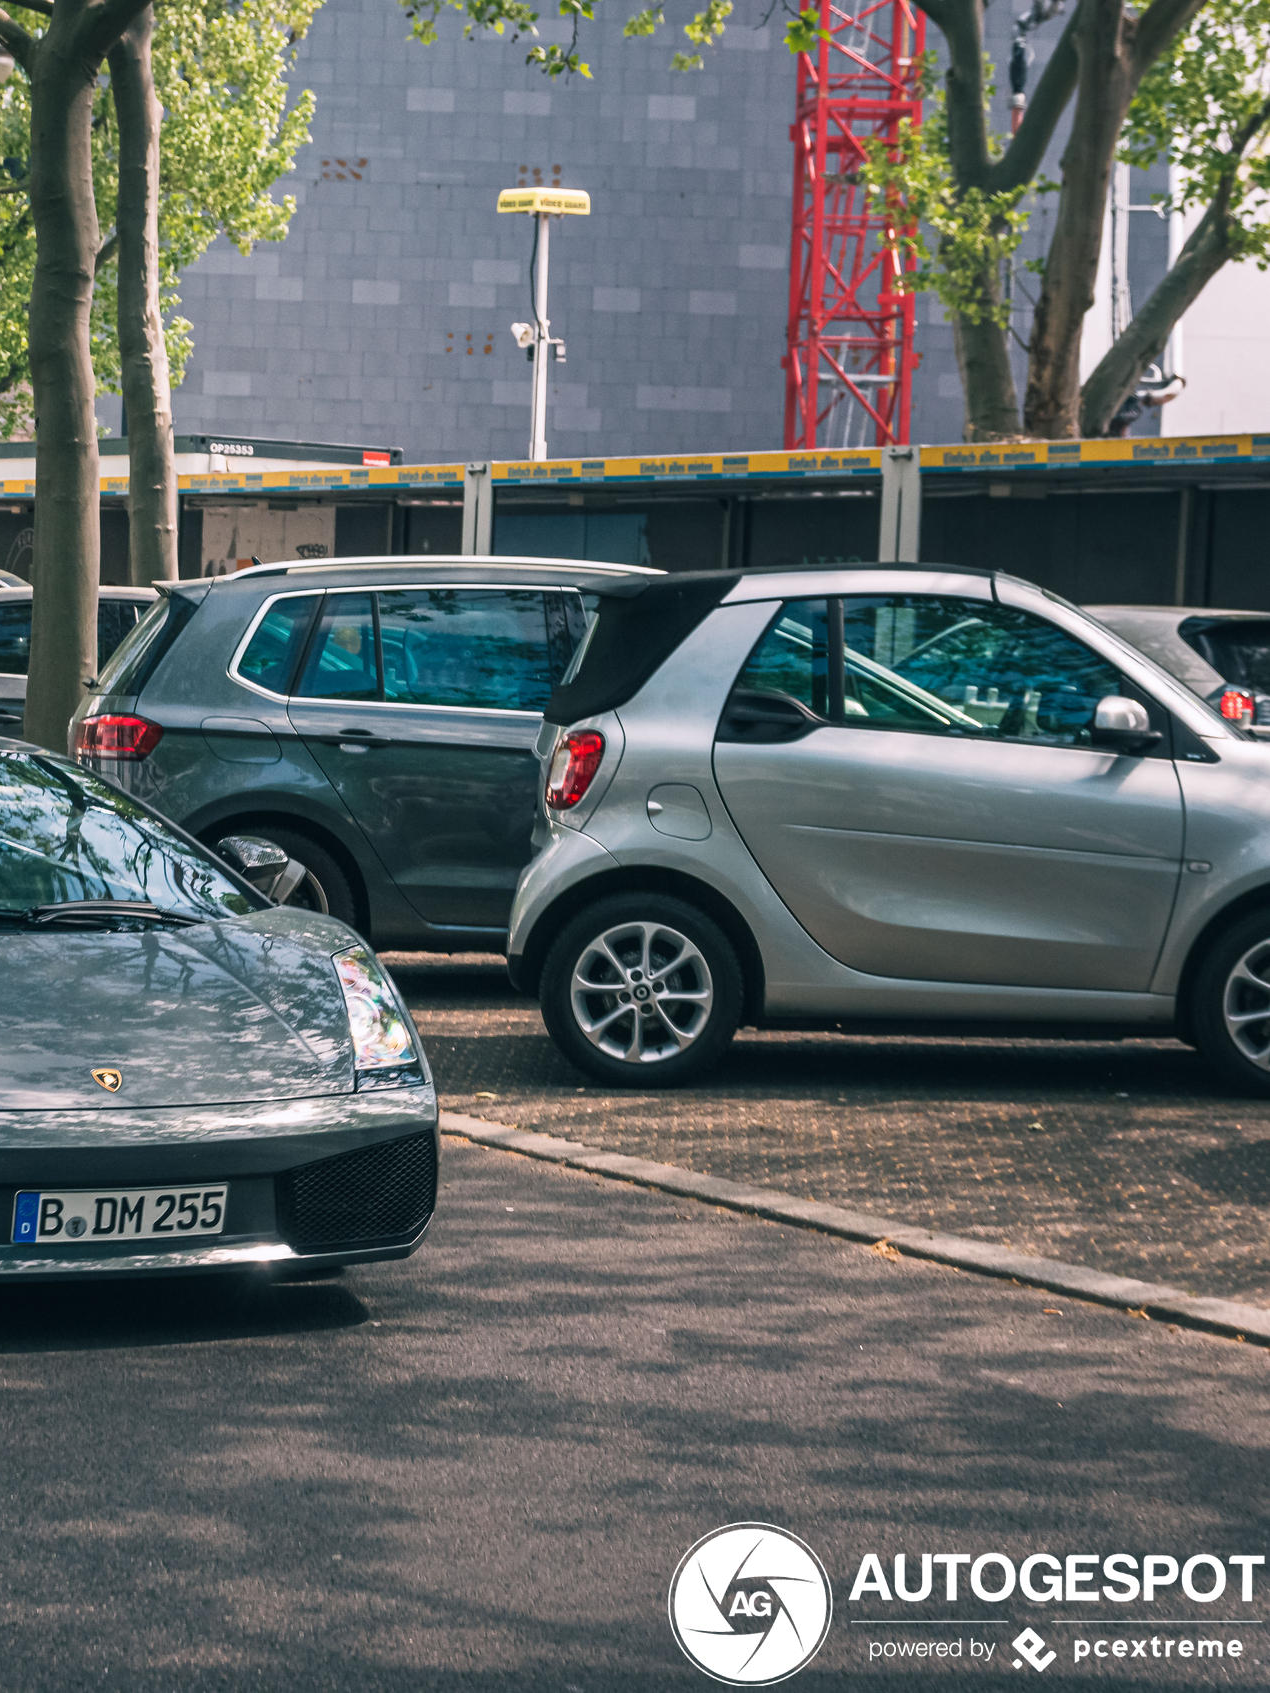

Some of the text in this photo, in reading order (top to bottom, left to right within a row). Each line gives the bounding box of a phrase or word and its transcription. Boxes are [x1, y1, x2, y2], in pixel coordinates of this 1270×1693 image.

[540, 199, 562, 207] VIDEO
[209, 442, 254, 456] OP25353
[38, 1191, 224, 1236] B DM 255
[20, 1222, 30, 1234] D
